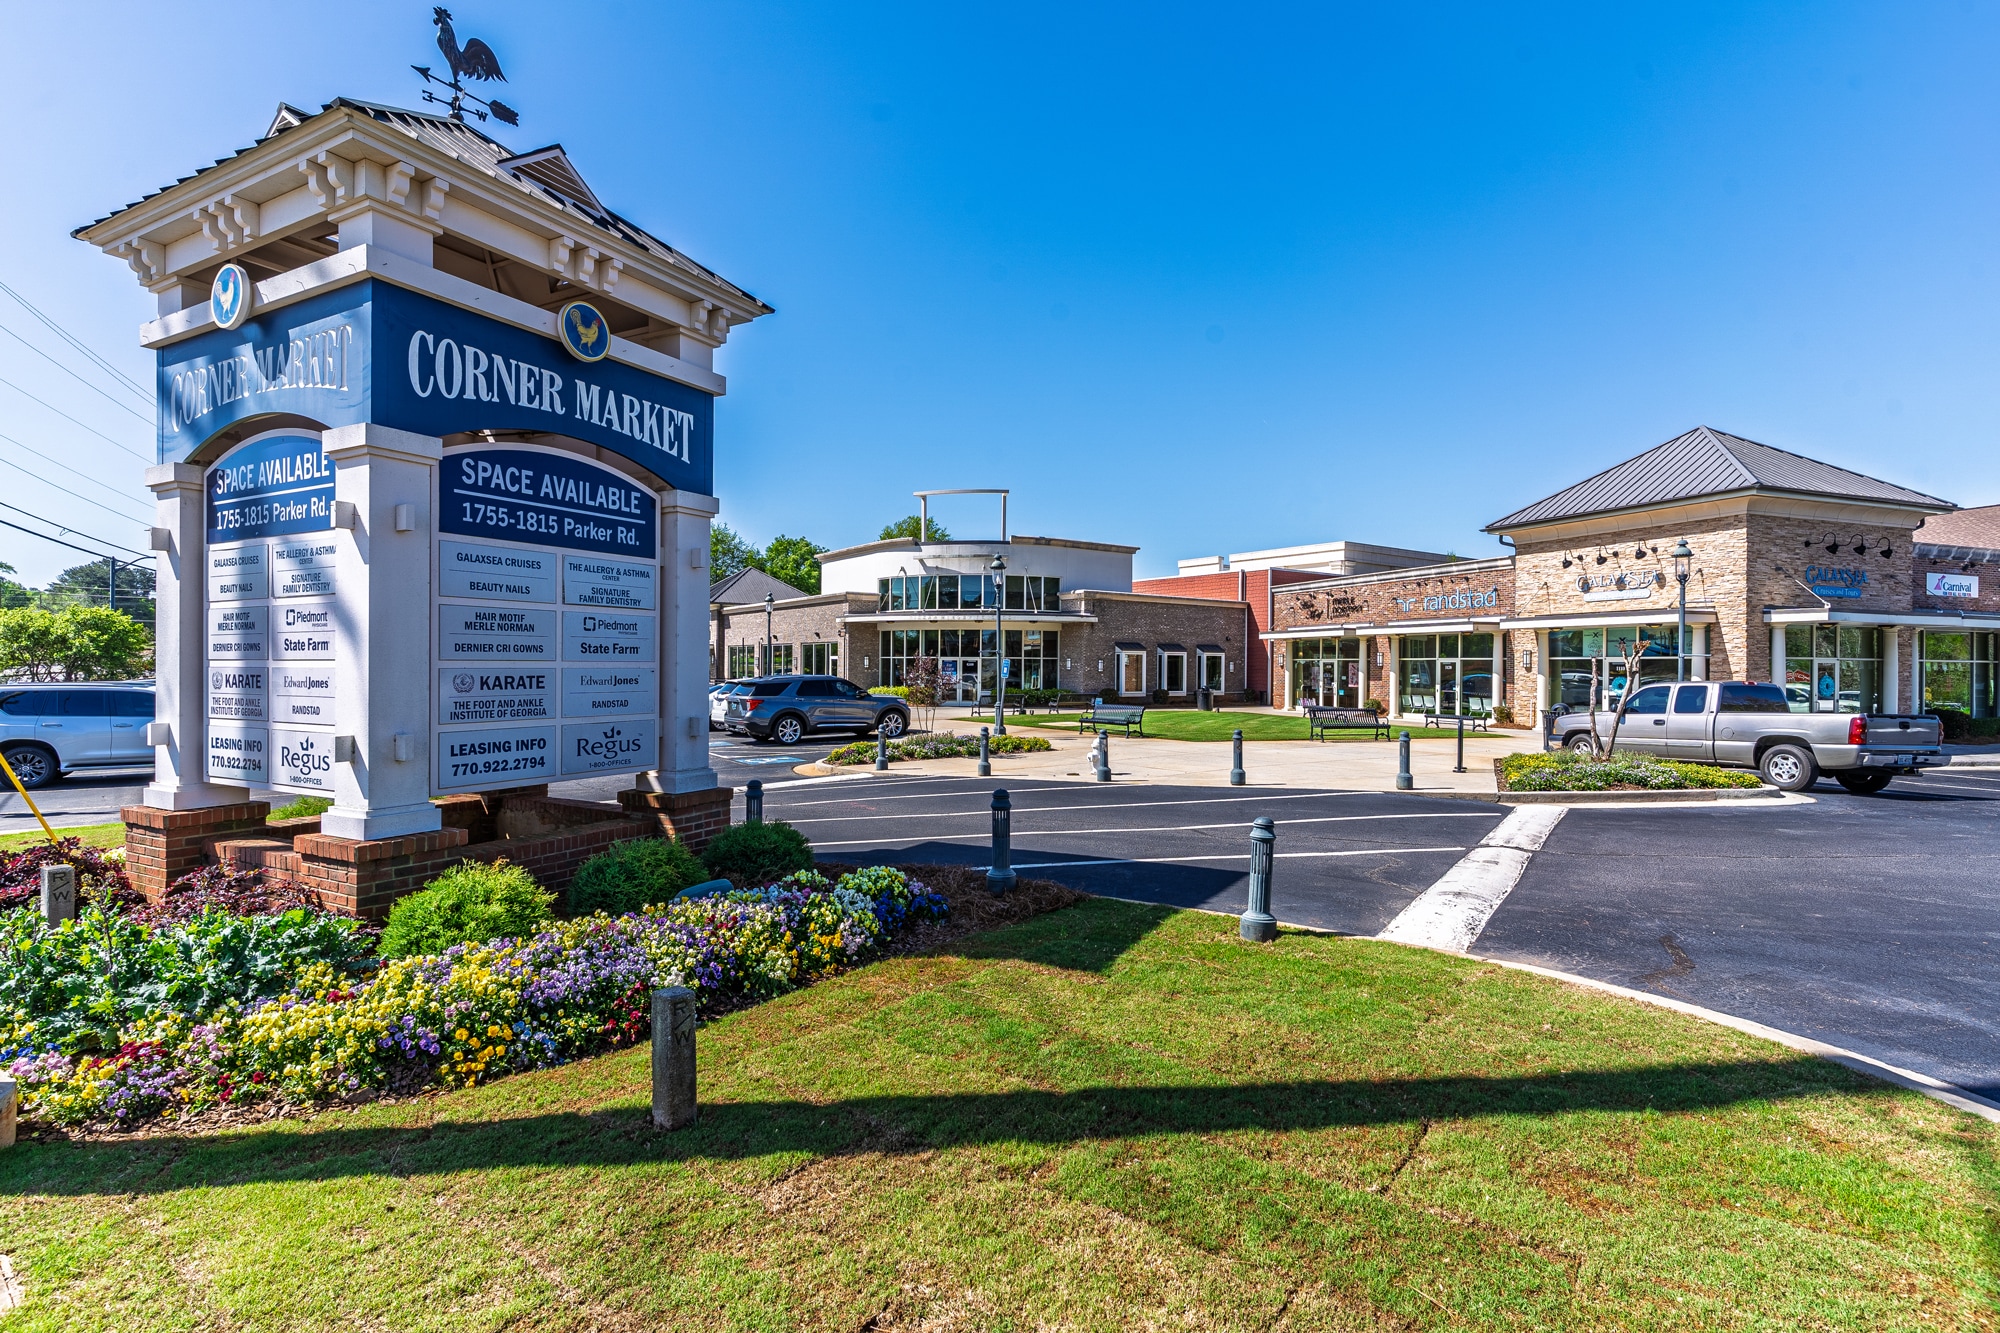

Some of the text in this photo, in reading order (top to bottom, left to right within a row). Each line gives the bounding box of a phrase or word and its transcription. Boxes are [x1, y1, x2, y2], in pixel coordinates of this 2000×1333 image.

[171, 325, 352, 432] CORNER MARKET
[408, 330, 694, 464] CORNER MARKET
[217, 452, 330, 494] SPACE AVAILABLE
[462, 458, 641, 514] SPACE AVAILABLE
[216, 496, 328, 530] 1755-1815 Parker Rd.
[462, 502, 640, 546] 1755-1815 Parker Rd.
[276, 550, 286, 560] THE
[286, 548, 309, 558] ALLERGY
[310, 548, 314, 557] &
[214, 555, 259, 568] GALAXSEA CRUISES
[456, 552, 542, 570] GALAXSEA CRUISES
[569, 562, 582, 572] THE
[584, 565, 614, 575] ALLERGY
[623, 569, 650, 579] ASTHMA
[291, 573, 321, 583] SIGNATURE
[220, 583, 253, 593] BEAUTY NAILS
[283, 582, 330, 593] FAMILY DENTISTRY
[470, 581, 530, 594] BEAUTY NAILS
[591, 587, 630, 598] SIGNATURE
[1943, 582, 1971, 592] Carnival
[579, 595, 641, 607] FAMILY DENTISTRY
[1424, 585, 1497, 610] randstad
[223, 612, 250, 621] HAIR MOTIF
[297, 611, 328, 622] Piedmont
[475, 612, 525, 622] HAIR MOTIF
[218, 621, 256, 631] MERLE NORMAN
[464, 622, 535, 632] MERLE NORMAN
[598, 620, 638, 631] Piedmont
[213, 642, 261, 652] DERNIER CRI GOWNS
[284, 638, 329, 651] State Farm
[454, 643, 544, 653] DERNIER CRI GOWNS
[580, 642, 639, 654] State Farm
[225, 674, 261, 689] KARATE
[480, 675, 546, 691] KARATE
[212, 697, 261, 707] THE FOOT AND ANKLE
[453, 698, 544, 710] THE FOOT AND ANKLE
[592, 699, 629, 708] RANDSTAD
[211, 706, 262, 717] INSTITUTE OF GEORGIA
[292, 705, 320, 715] RANDSTAD
[450, 708, 547, 720] INSTITUTE OF GEORGIA
[211, 737, 262, 752] LEASING INFO
[450, 738, 546, 757] LEASING INFO
[577, 738, 641, 759] Regus
[212, 756, 262, 771] 770.922.2794
[281, 746, 330, 775] Regus
[452, 756, 546, 776] 770.922.2794
[589, 759, 631, 768] 1-800-OFFICES
